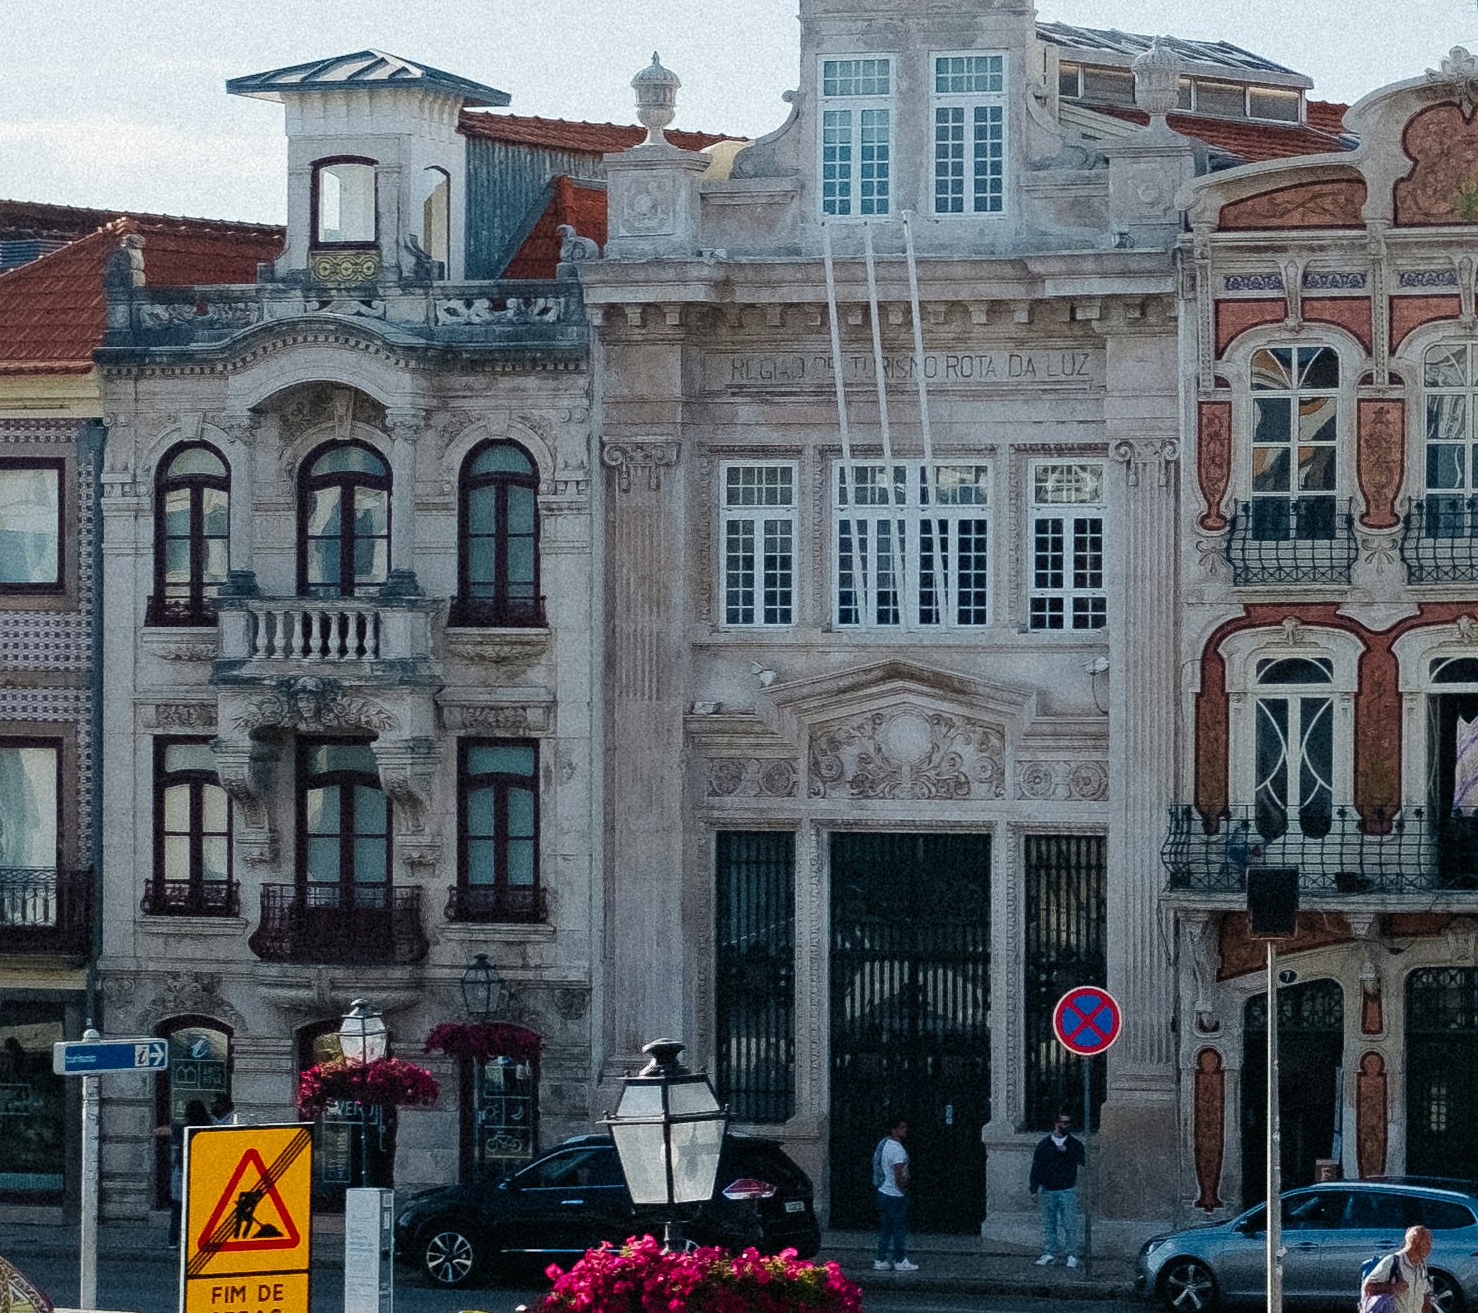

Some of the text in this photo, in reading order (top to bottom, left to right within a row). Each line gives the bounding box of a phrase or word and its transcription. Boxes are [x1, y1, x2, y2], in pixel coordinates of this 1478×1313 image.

[945, 354, 998, 379] ROTA
[1008, 353, 1037, 378] DA
[1046, 352, 1090, 377] LUZ
[211, 1283, 284, 1304] FIM DE
